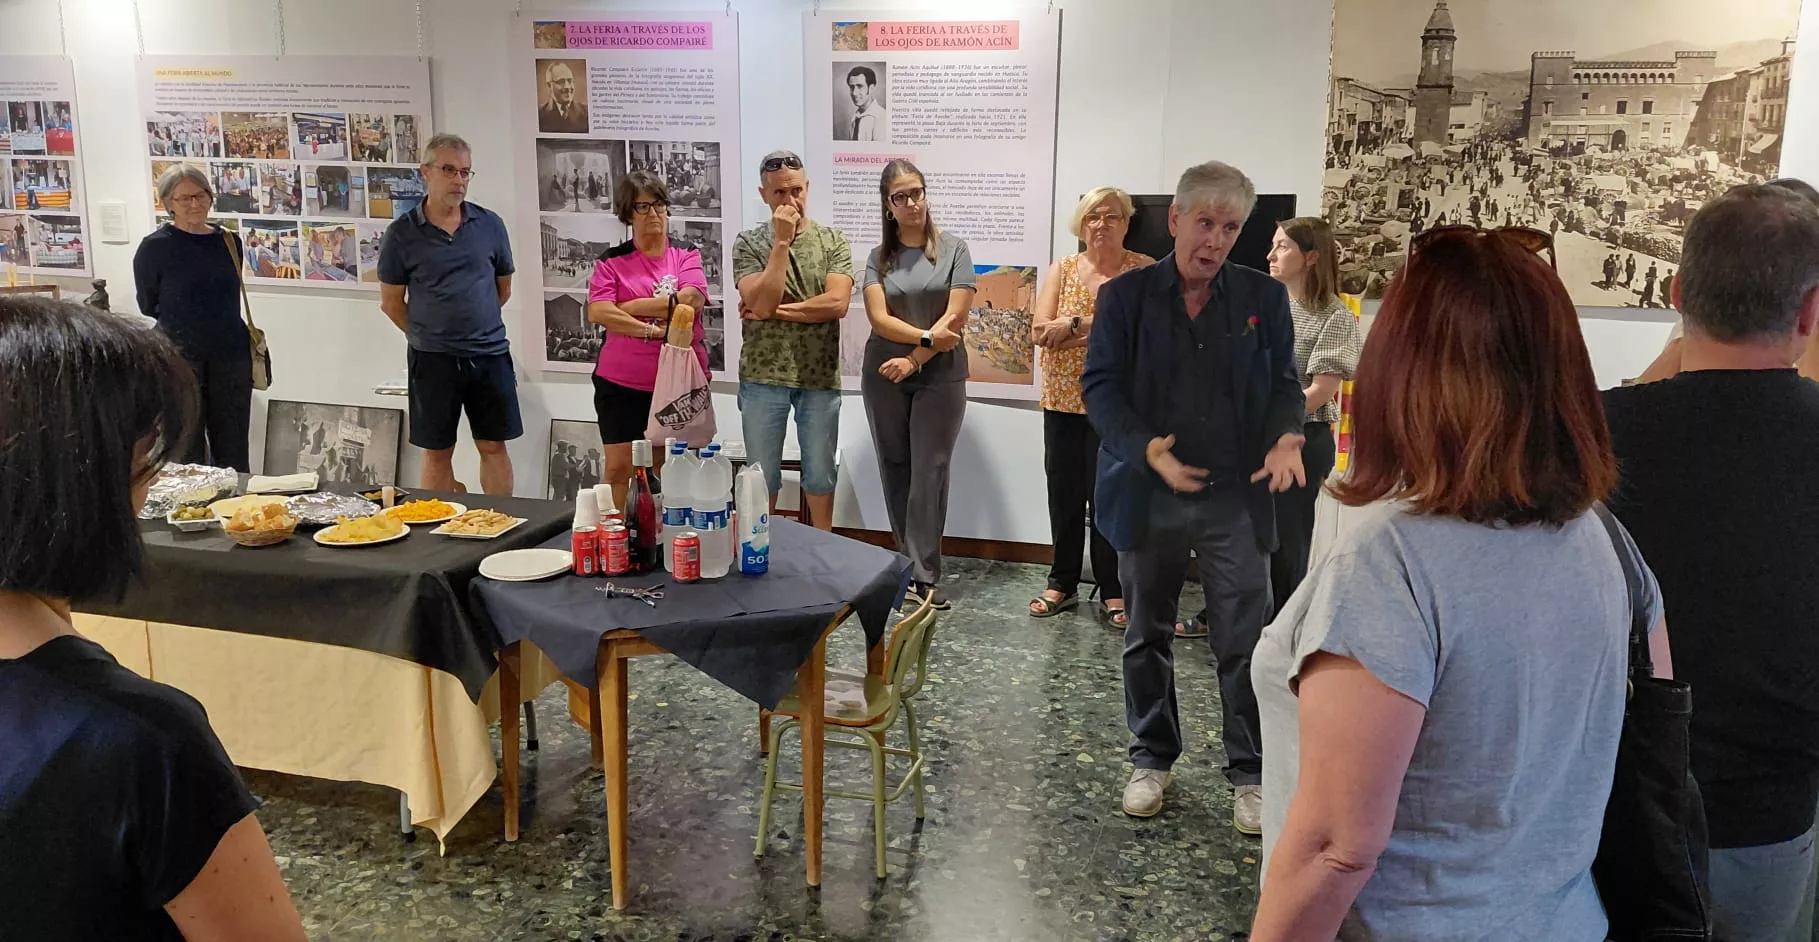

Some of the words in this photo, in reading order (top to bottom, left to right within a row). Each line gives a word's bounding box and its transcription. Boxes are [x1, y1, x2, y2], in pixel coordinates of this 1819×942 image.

[570, 25, 576, 34] 7.
[580, 25, 591, 34] LA
[593, 25, 621, 34] FERIA
[621, 25, 629, 34] A
[631, 24, 669, 34] TRAVÉS
[671, 25, 685, 34] DE
[686, 25, 705, 34] LOS
[880, 26, 889, 35] 8.
[891, 26, 904, 35] LA
[906, 26, 937, 35] FERIA
[940, 26, 946, 35] A
[948, 24, 990, 34] TRAVÉS
[992, 25, 1008, 34] DE
[569, 37, 593, 47] OJOS
[595, 37, 609, 46] DE
[610, 37, 654, 46] RICARDO
[875, 38, 895, 47] LOS
[897, 38, 923, 49] OJOS
[926, 38, 941, 47] DE
[943, 36, 983, 47] RAMÓN
[985, 36, 1012, 46] ACÍN
